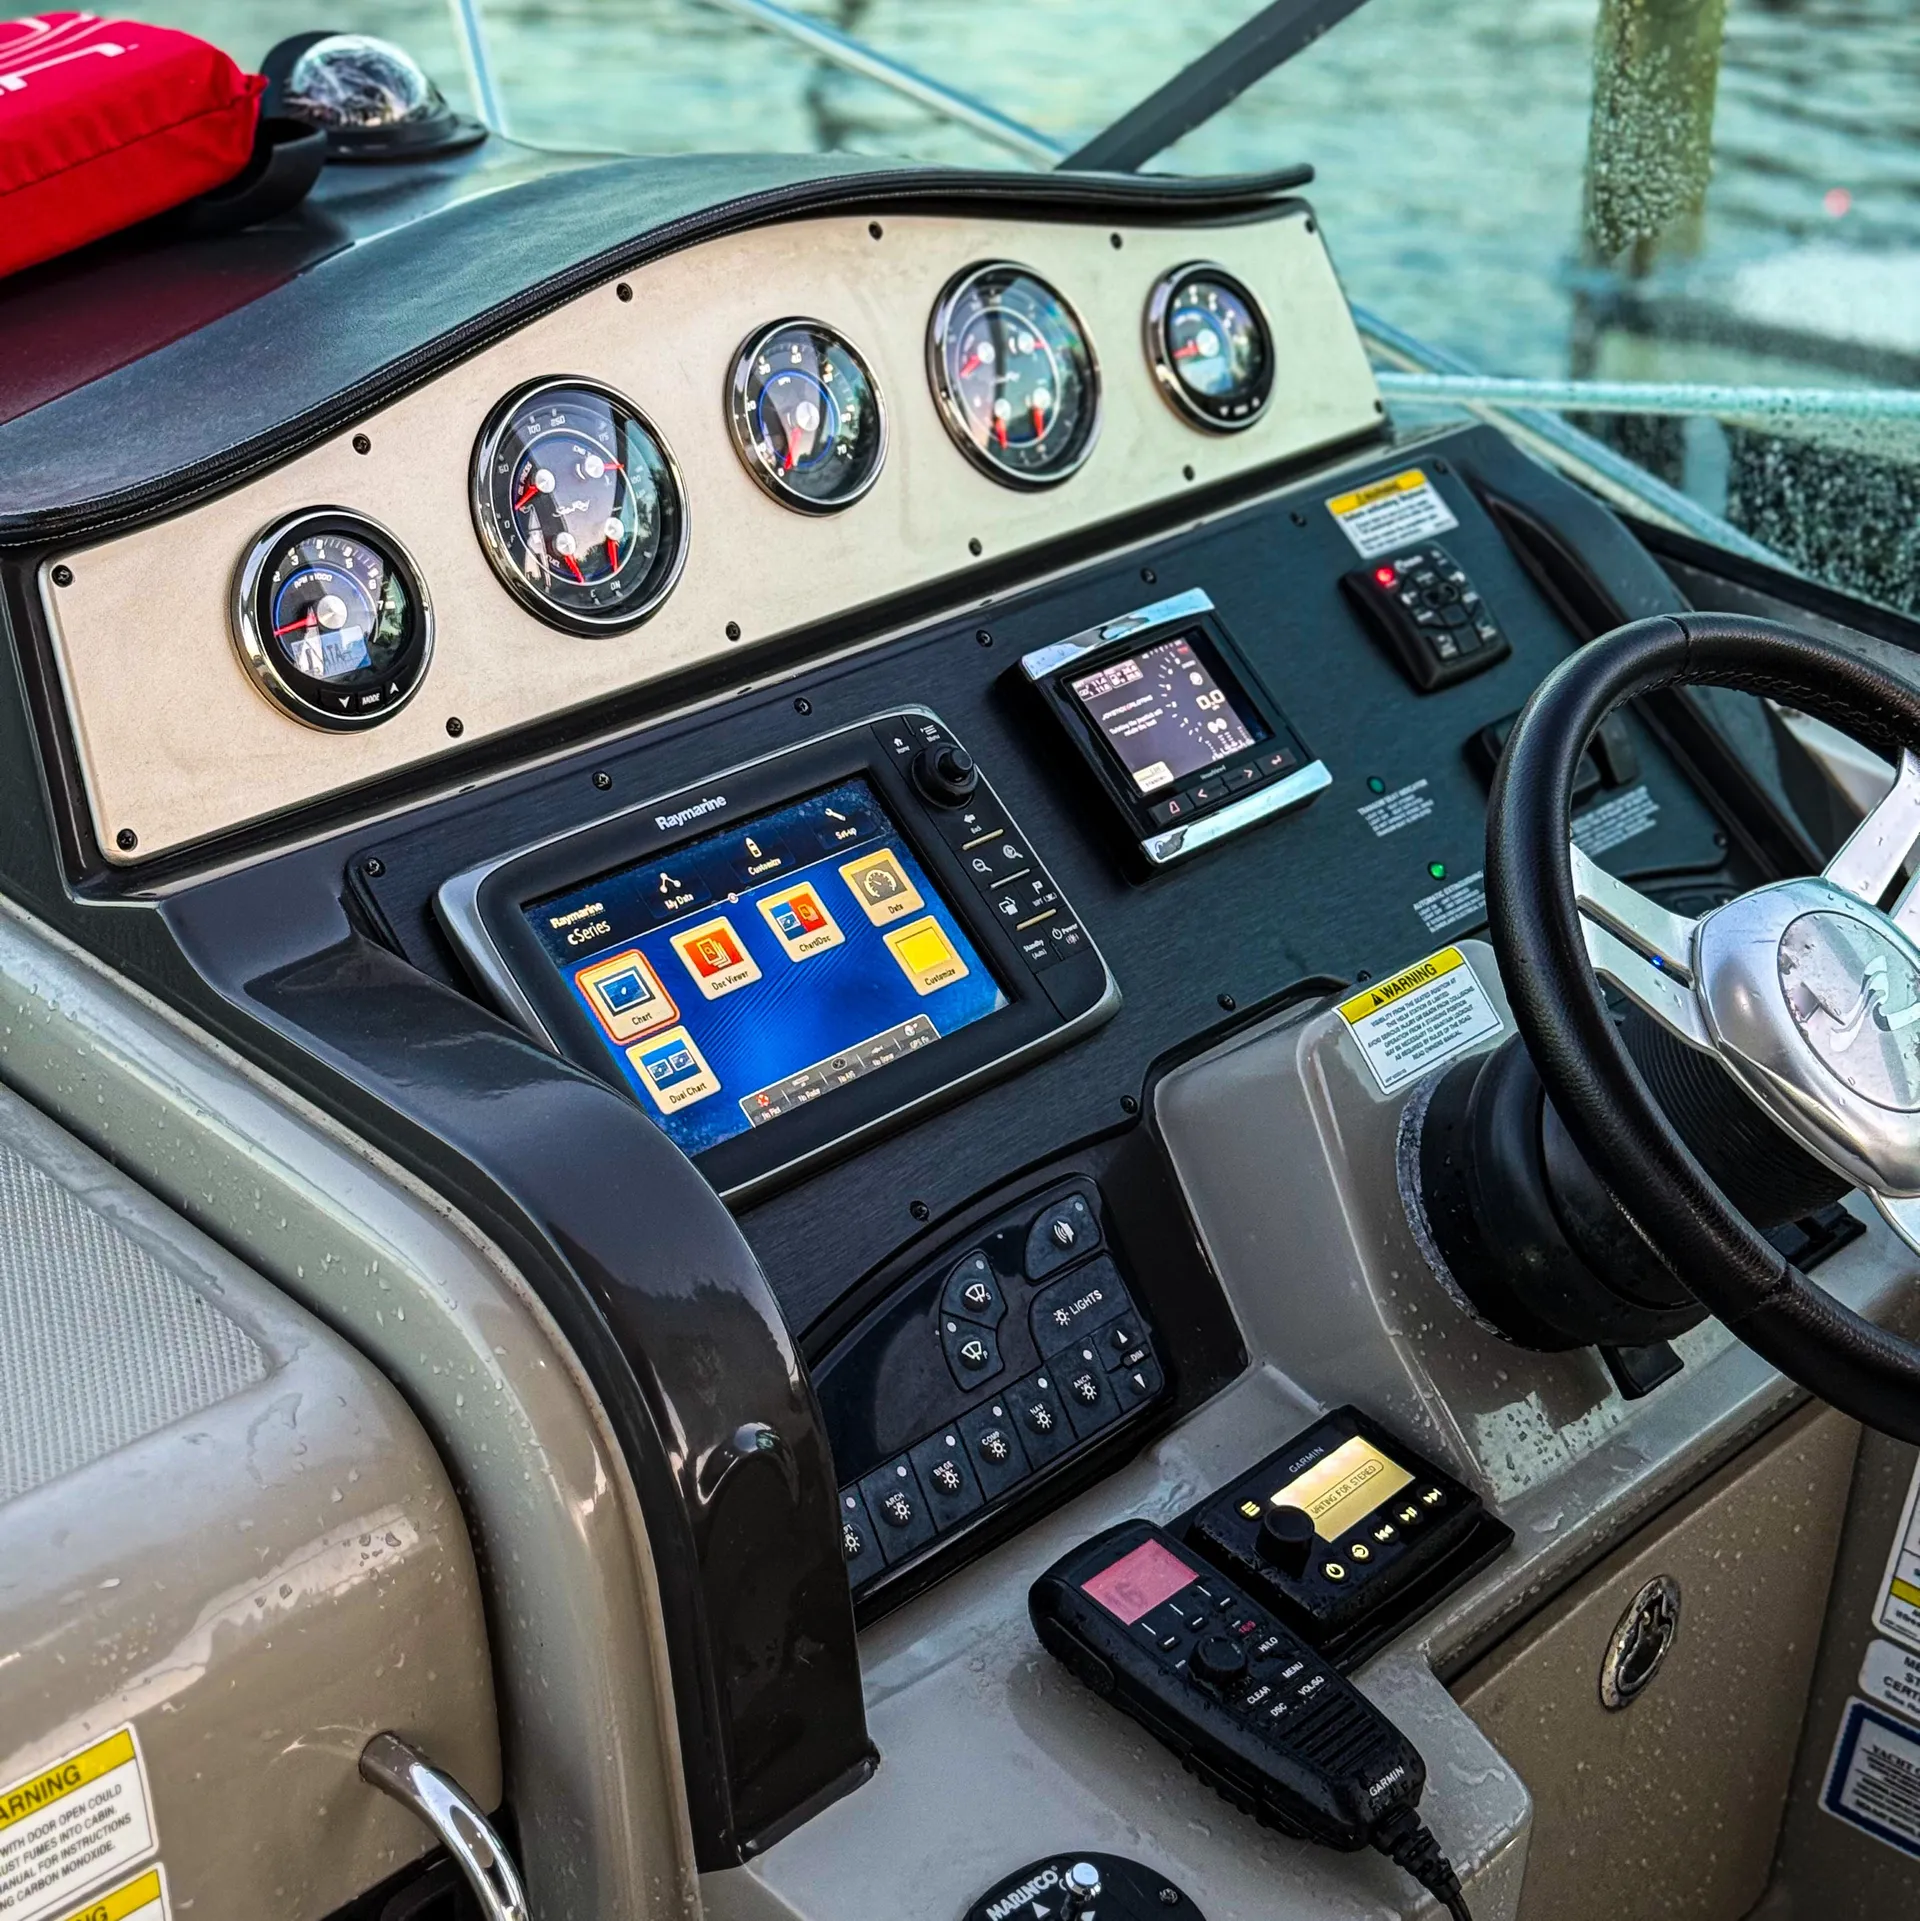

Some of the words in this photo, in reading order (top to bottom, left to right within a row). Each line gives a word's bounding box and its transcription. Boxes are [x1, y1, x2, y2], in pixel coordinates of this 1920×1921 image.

[528, 424, 541, 435] 100
[291, 556, 298, 566] 3
[314, 573, 332, 582] 1000
[362, 693, 380, 706] MODE
[655, 796, 727, 830] Raymarine
[664, 898, 678, 910] My
[676, 893, 694, 906] Data
[888, 903, 904, 914] Data
[550, 902, 604, 928] Raymarine
[567, 920, 611, 945] cSeries
[712, 980, 726, 991] Doc
[727, 970, 749, 984] Viewer
[924, 967, 956, 986] Customize
[1378, 962, 1438, 1001] WARNING
[632, 1012, 653, 1026] Chart
[670, 1090, 686, 1104] Dual
[686, 1082, 707, 1096] Chart
[986, 1292, 992, 1300] S
[1069, 1290, 1102, 1315] LIGHTS
[1130, 1350, 1145, 1362] DIM
[1073, 1374, 1092, 1388] ANCH
[1030, 1404, 1044, 1415] NAV
[982, 1431, 1000, 1446] COMP
[933, 1460, 954, 1477] BILGE
[1288, 1446, 1324, 1473] GARMIN
[1310, 1494, 1338, 1514] WAITING
[1336, 1484, 1352, 1497] FOR
[1350, 1465, 1376, 1486] STEREO
[885, 1492, 905, 1508] ARCH
[1258, 1636, 1279, 1653] HI/LO
[1282, 1662, 1304, 1679] MENU
[1298, 1675, 1324, 1696] VOL/SQ
[1247, 1686, 1271, 1704] CLEAR
[1270, 1703, 1287, 1717] DSC
[1370, 1765, 1405, 1796] GARMIN
[0, 1838, 26, 1858] WITH
[27, 1819, 57, 1843] DOOR
[58, 1803, 86, 1826] OPEN
[88, 1784, 122, 1810] COULD
[23, 1837, 58, 1863] FUMES
[59, 1824, 83, 1844] INTO
[84, 1805, 117, 1830] CABIN.
[38, 1853, 59, 1872] FOR
[60, 1813, 132, 1859] INSTRUCTIONS
[16, 1871, 60, 1900] CARBON
[61, 1840, 116, 1877] MONOXIDE.
[986, 1870, 1058, 1921] MARINCO
